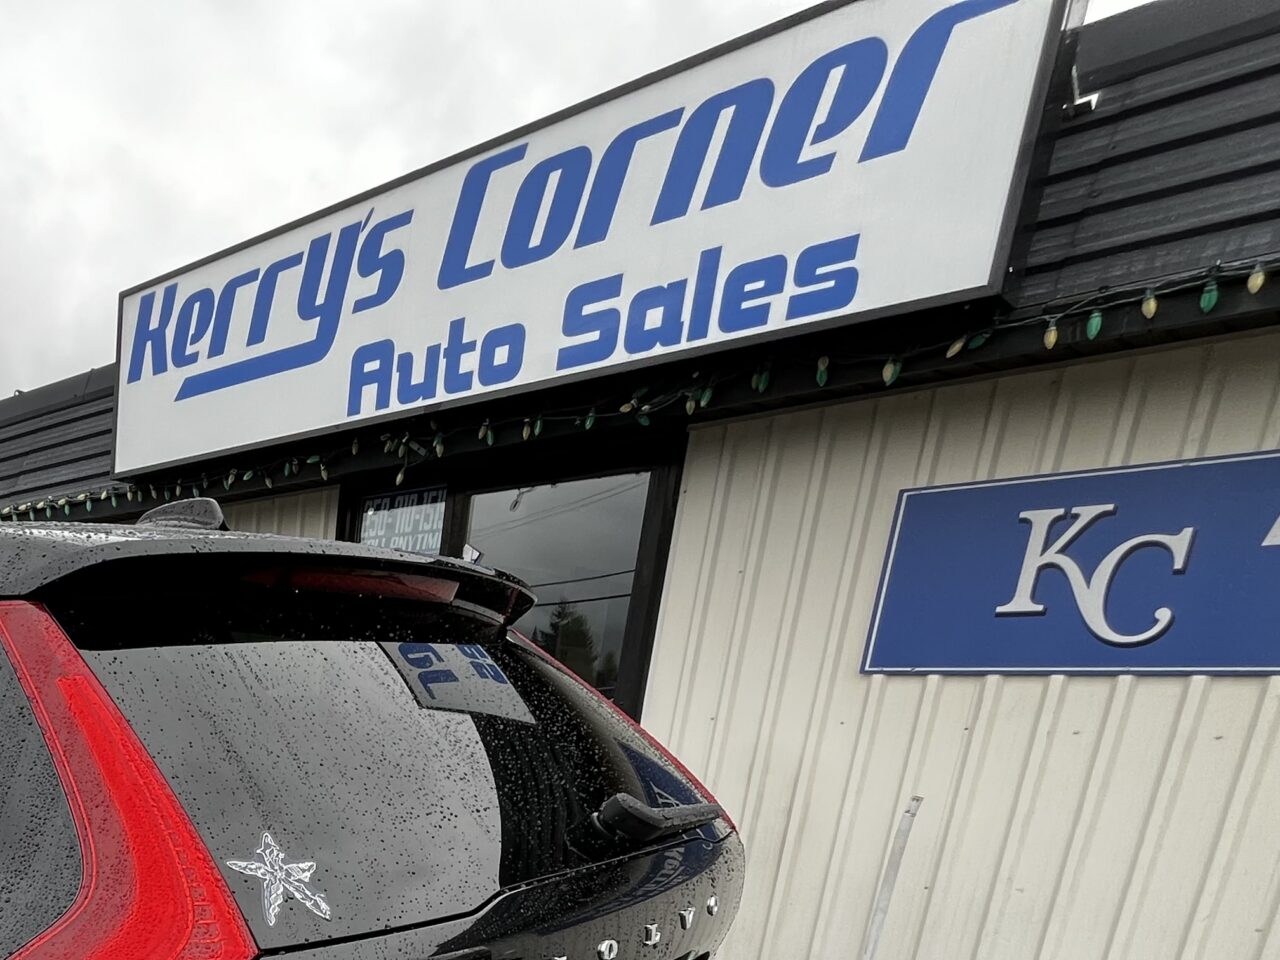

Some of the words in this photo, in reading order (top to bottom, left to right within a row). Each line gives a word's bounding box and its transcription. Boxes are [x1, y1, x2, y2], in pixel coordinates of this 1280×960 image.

[127, 207, 414, 402] Kerry's
[437, 0, 1019, 291] Corner
[347, 317, 526, 417] Auto
[556, 234, 860, 372] Sales
[995, 503, 1195, 648] KC
